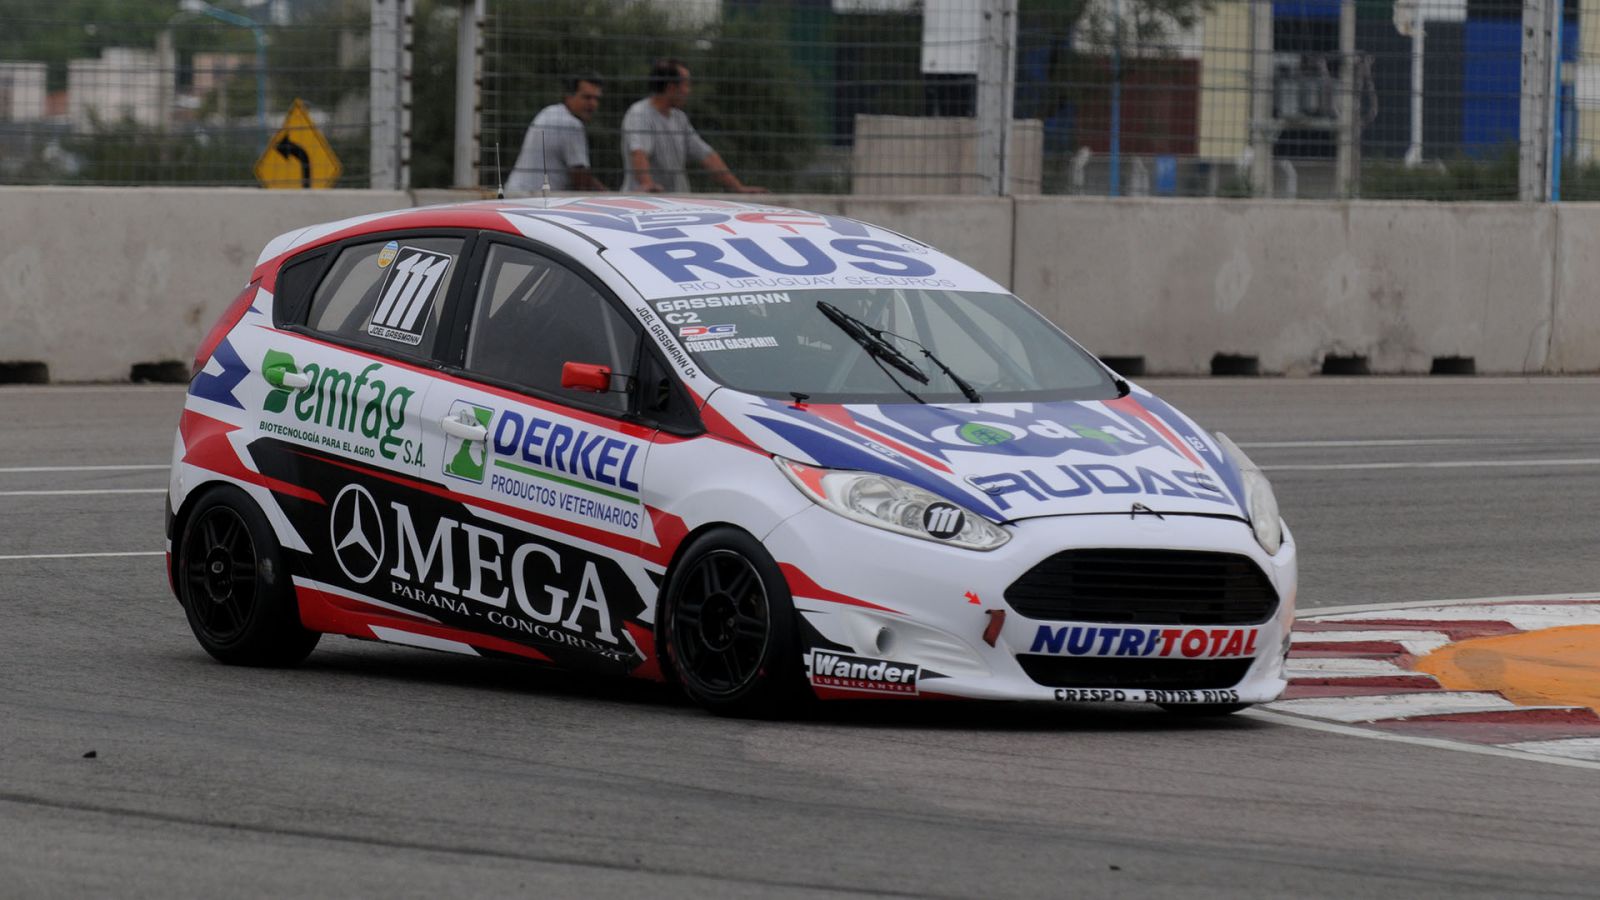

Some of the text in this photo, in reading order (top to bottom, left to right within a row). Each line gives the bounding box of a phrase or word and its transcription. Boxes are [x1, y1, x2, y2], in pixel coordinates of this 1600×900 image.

[372, 252, 449, 331] 111
[679, 275, 957, 293] RIO URUGUAY SEGUROS
[656, 292, 791, 312] GASSMANN
[665, 312, 701, 325] C2
[635, 306, 655, 326] JOEL
[650, 323, 689, 369] GASSMANN
[684, 340, 726, 353] FUERZA
[259, 420, 375, 458] BIOTECNOLOGÍA PARA EL AGRO
[493, 409, 639, 492] DERKEL
[403, 440, 426, 468] S.A.
[491, 474, 639, 530] PRODUCTOS VETERINARIOS
[927, 506, 961, 533] 111
[391, 582, 470, 616] PARANA
[815, 653, 914, 683] Wander
[816, 677, 913, 692] LUBRICANTES
[1054, 688, 1127, 703] CRESPO
[1144, 689, 1199, 704] ENTRE
[1200, 689, 1240, 704] RIOS
